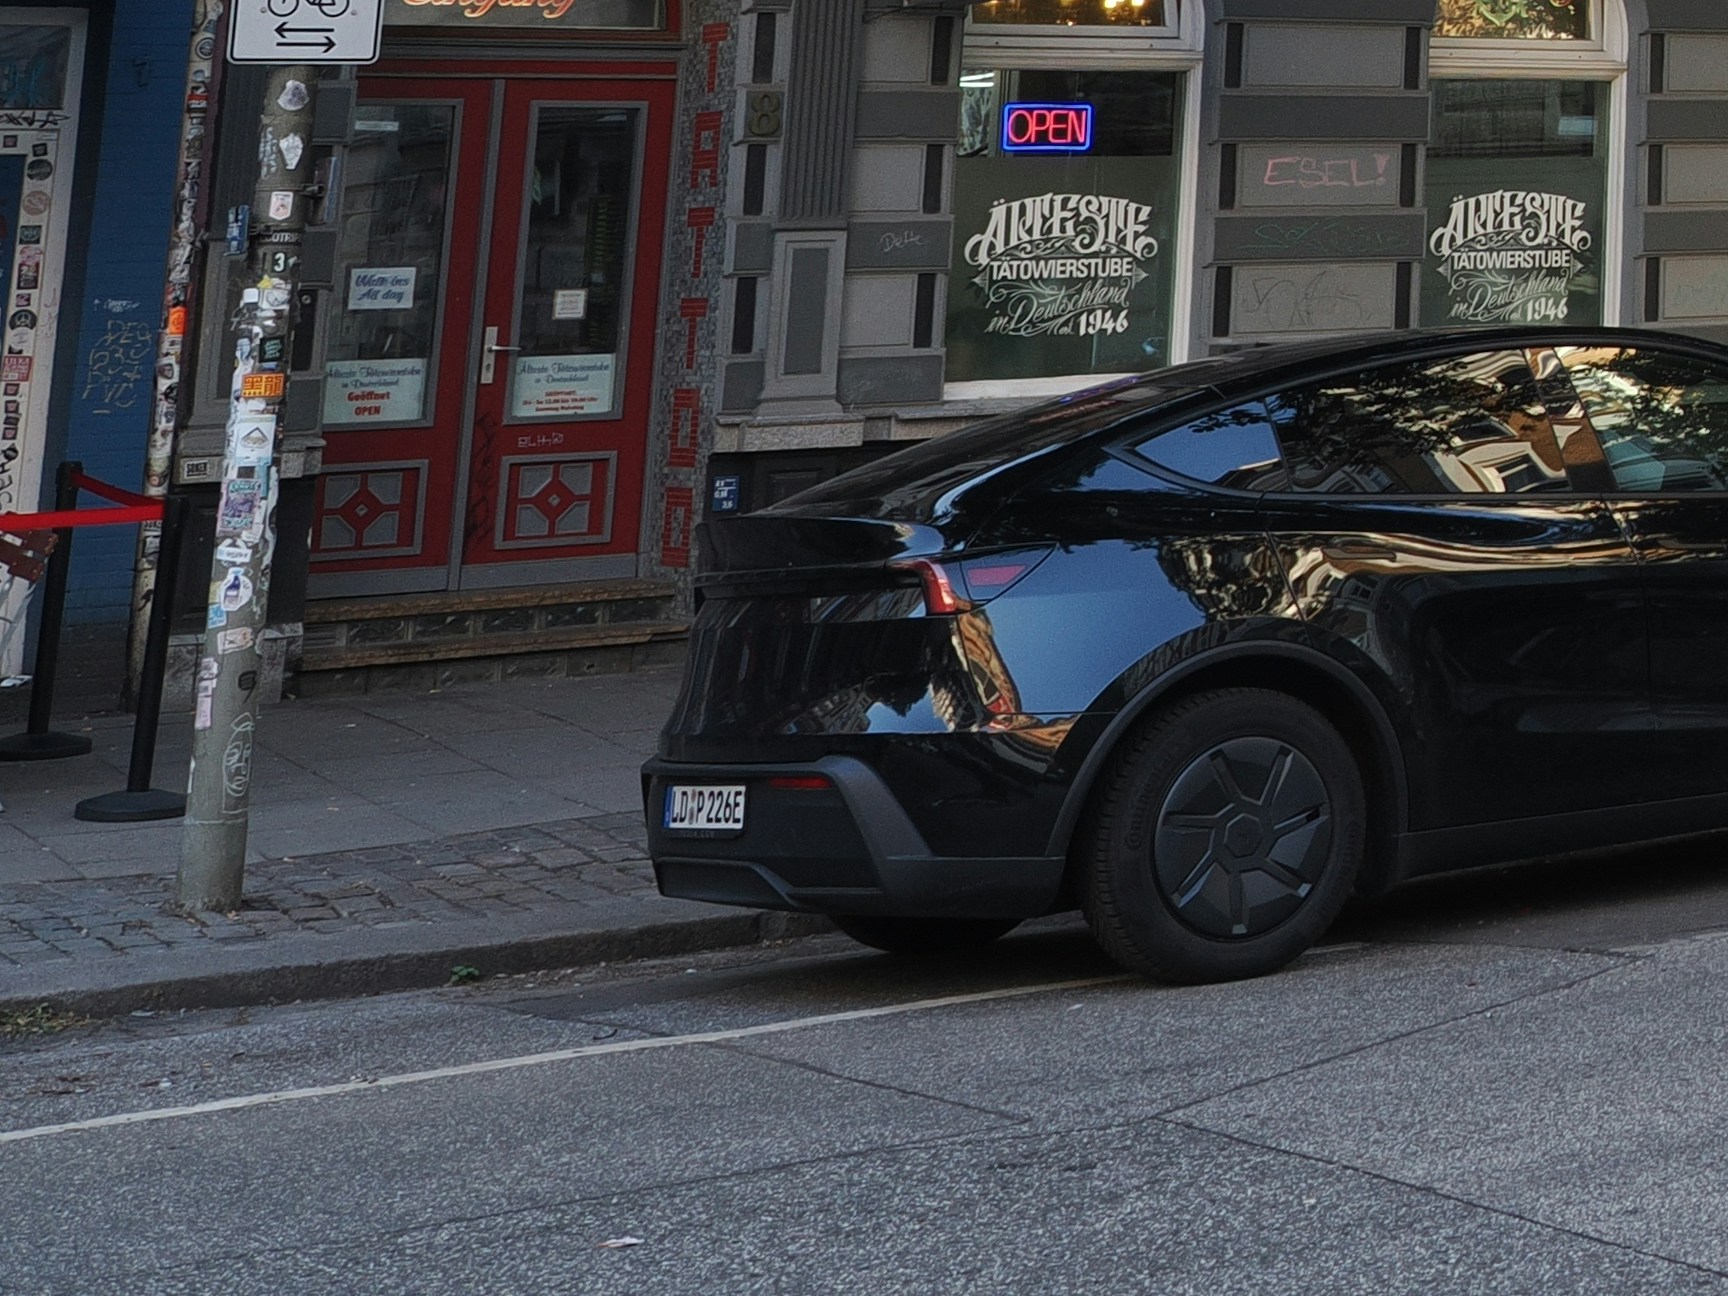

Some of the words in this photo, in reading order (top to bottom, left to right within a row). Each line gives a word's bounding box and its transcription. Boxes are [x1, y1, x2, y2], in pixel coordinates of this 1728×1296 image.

[749, 92, 781, 139] 8
[1009, 110, 1087, 143] OPEN
[990, 256, 1133, 280] TÄTOWIERSTUBE
[1451, 248, 1571, 270] TÄTOWIERSTUBE
[1008, 278, 1129, 329] Deutschland
[1467, 268, 1568, 315] Deutschland
[1079, 309, 1128, 336] 1946
[1526, 297, 1569, 322] 1946
[354, 406, 381, 416] OPEN
[671, 790, 689, 823] LD
[706, 790, 743, 823] 226E
